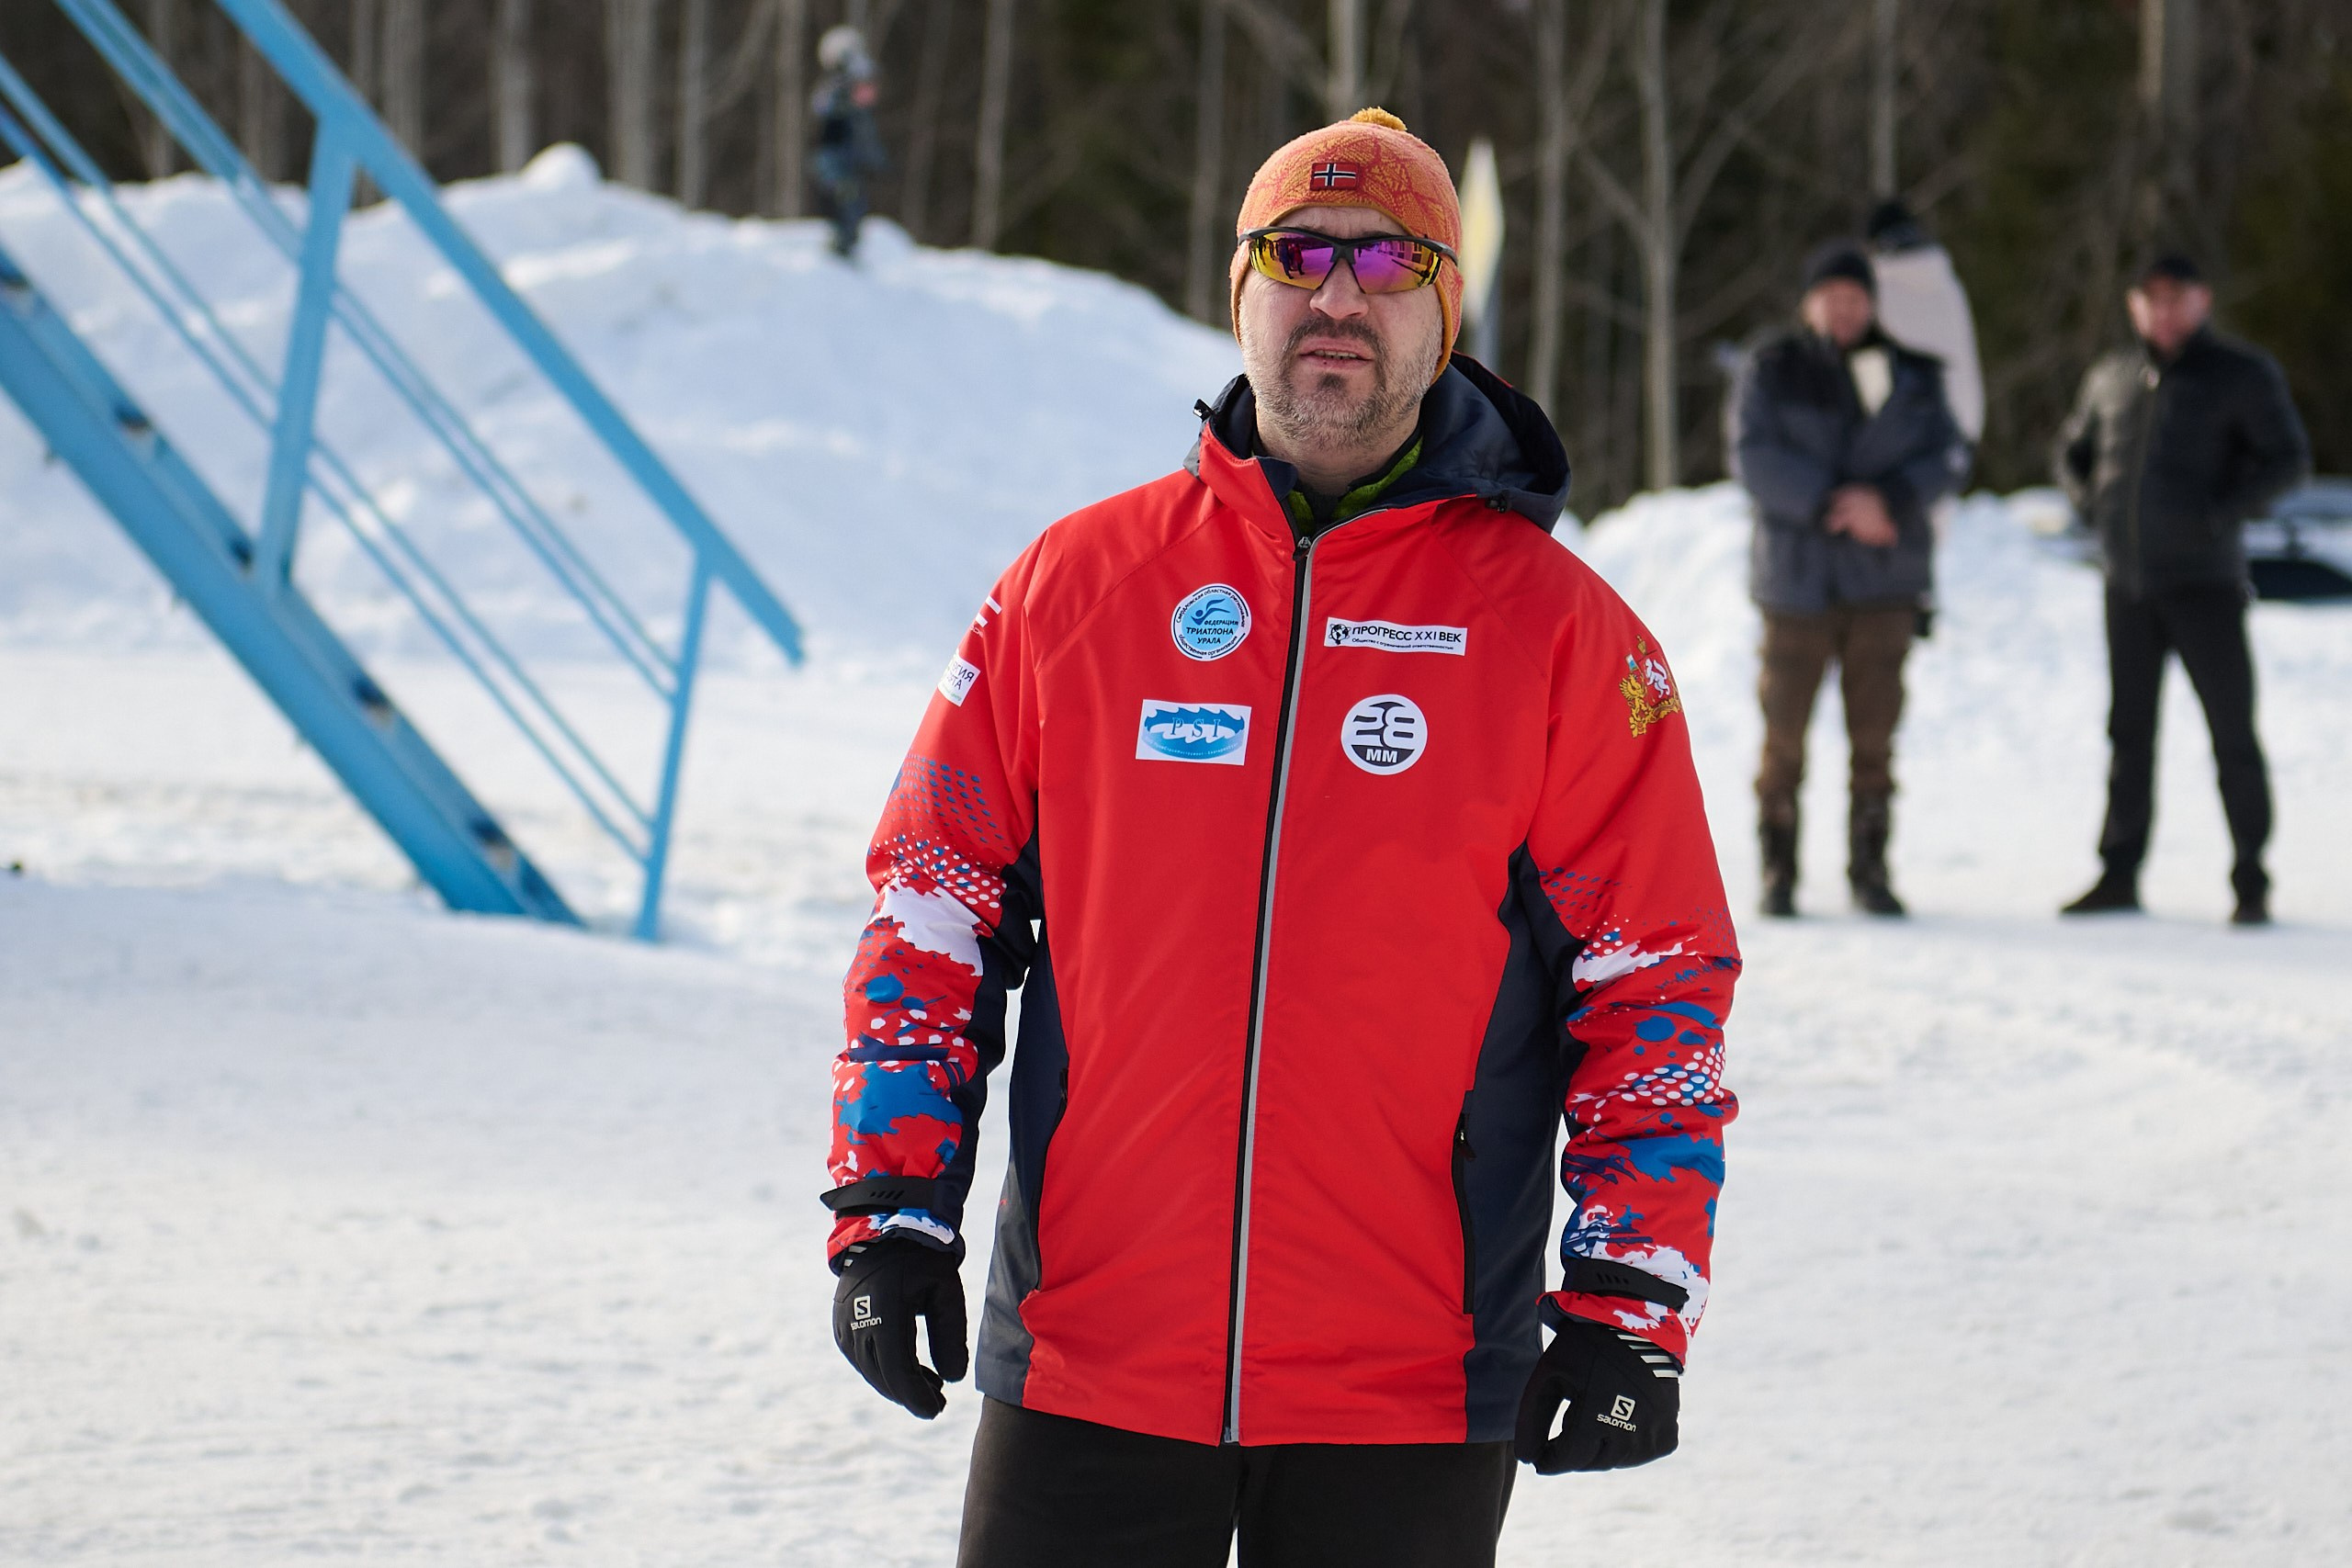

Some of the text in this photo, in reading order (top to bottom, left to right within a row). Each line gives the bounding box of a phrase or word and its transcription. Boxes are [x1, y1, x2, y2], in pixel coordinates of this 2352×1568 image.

[1185, 626, 1234, 636] ТРИАТЛОНА
[1351, 626, 1412, 641] ПРОГРЕСС
[1439, 632, 1462, 643] ВЕК
[1351, 704, 1418, 750] 28
[1597, 1414, 1636, 1432] salomon
